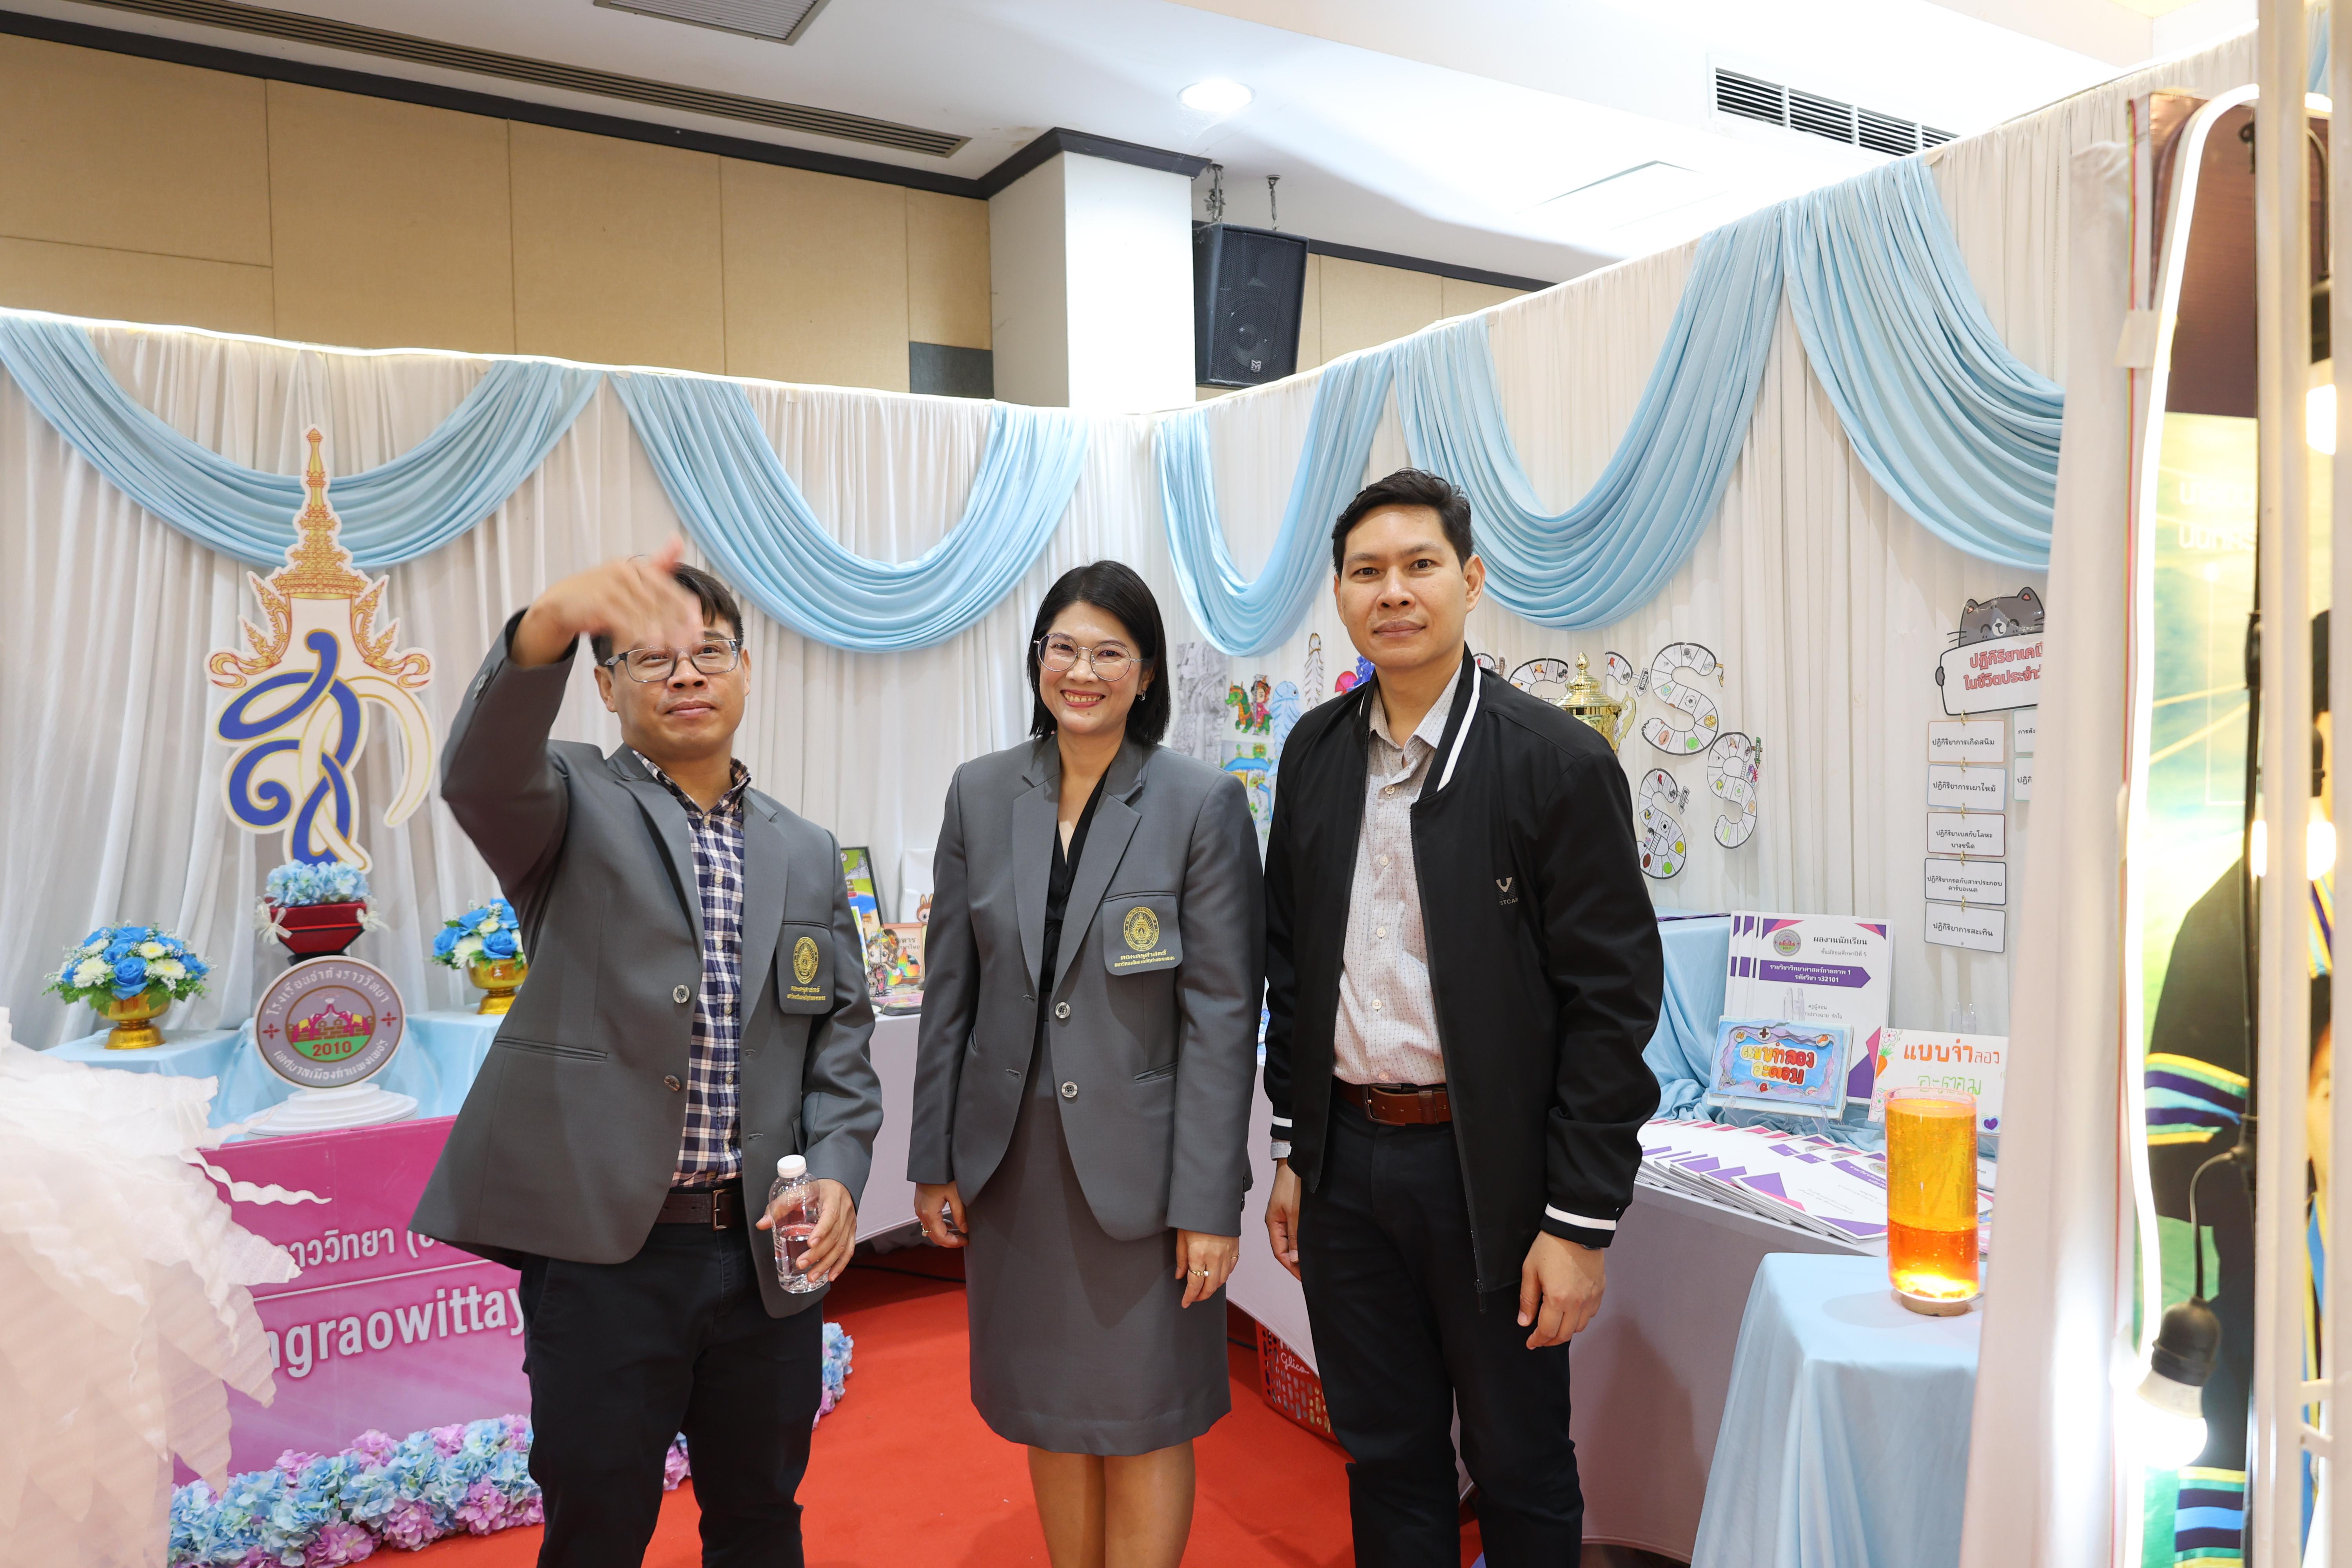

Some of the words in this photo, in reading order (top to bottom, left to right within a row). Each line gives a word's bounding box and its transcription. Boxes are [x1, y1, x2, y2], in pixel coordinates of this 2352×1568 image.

[1964, 664, 2042, 690] ในชีวิตประจำ
[1813, 936, 1867, 945] ผลงานนักเรียน
[312, 1041, 352, 1056] 2010
[277, 1228, 396, 1267] าววิทยา
[1281, 1352, 1310, 1374] Glico
